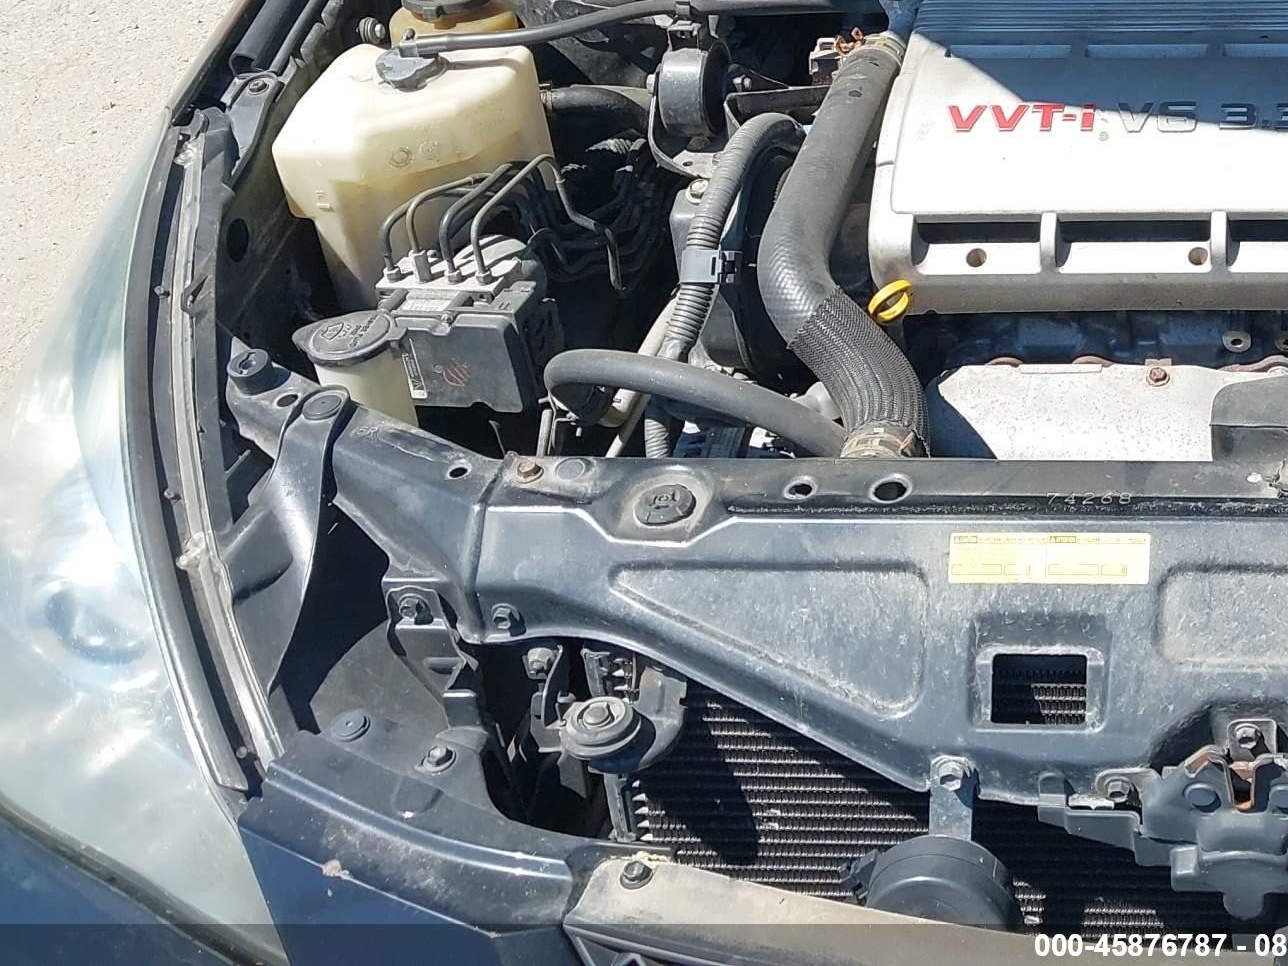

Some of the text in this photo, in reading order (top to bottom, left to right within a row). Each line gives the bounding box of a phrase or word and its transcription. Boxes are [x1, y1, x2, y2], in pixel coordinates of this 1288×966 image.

[948, 103, 1097, 132] VVT-i
[1117, 102, 1198, 134] V6
[1046, 491, 1133, 505] 74268
